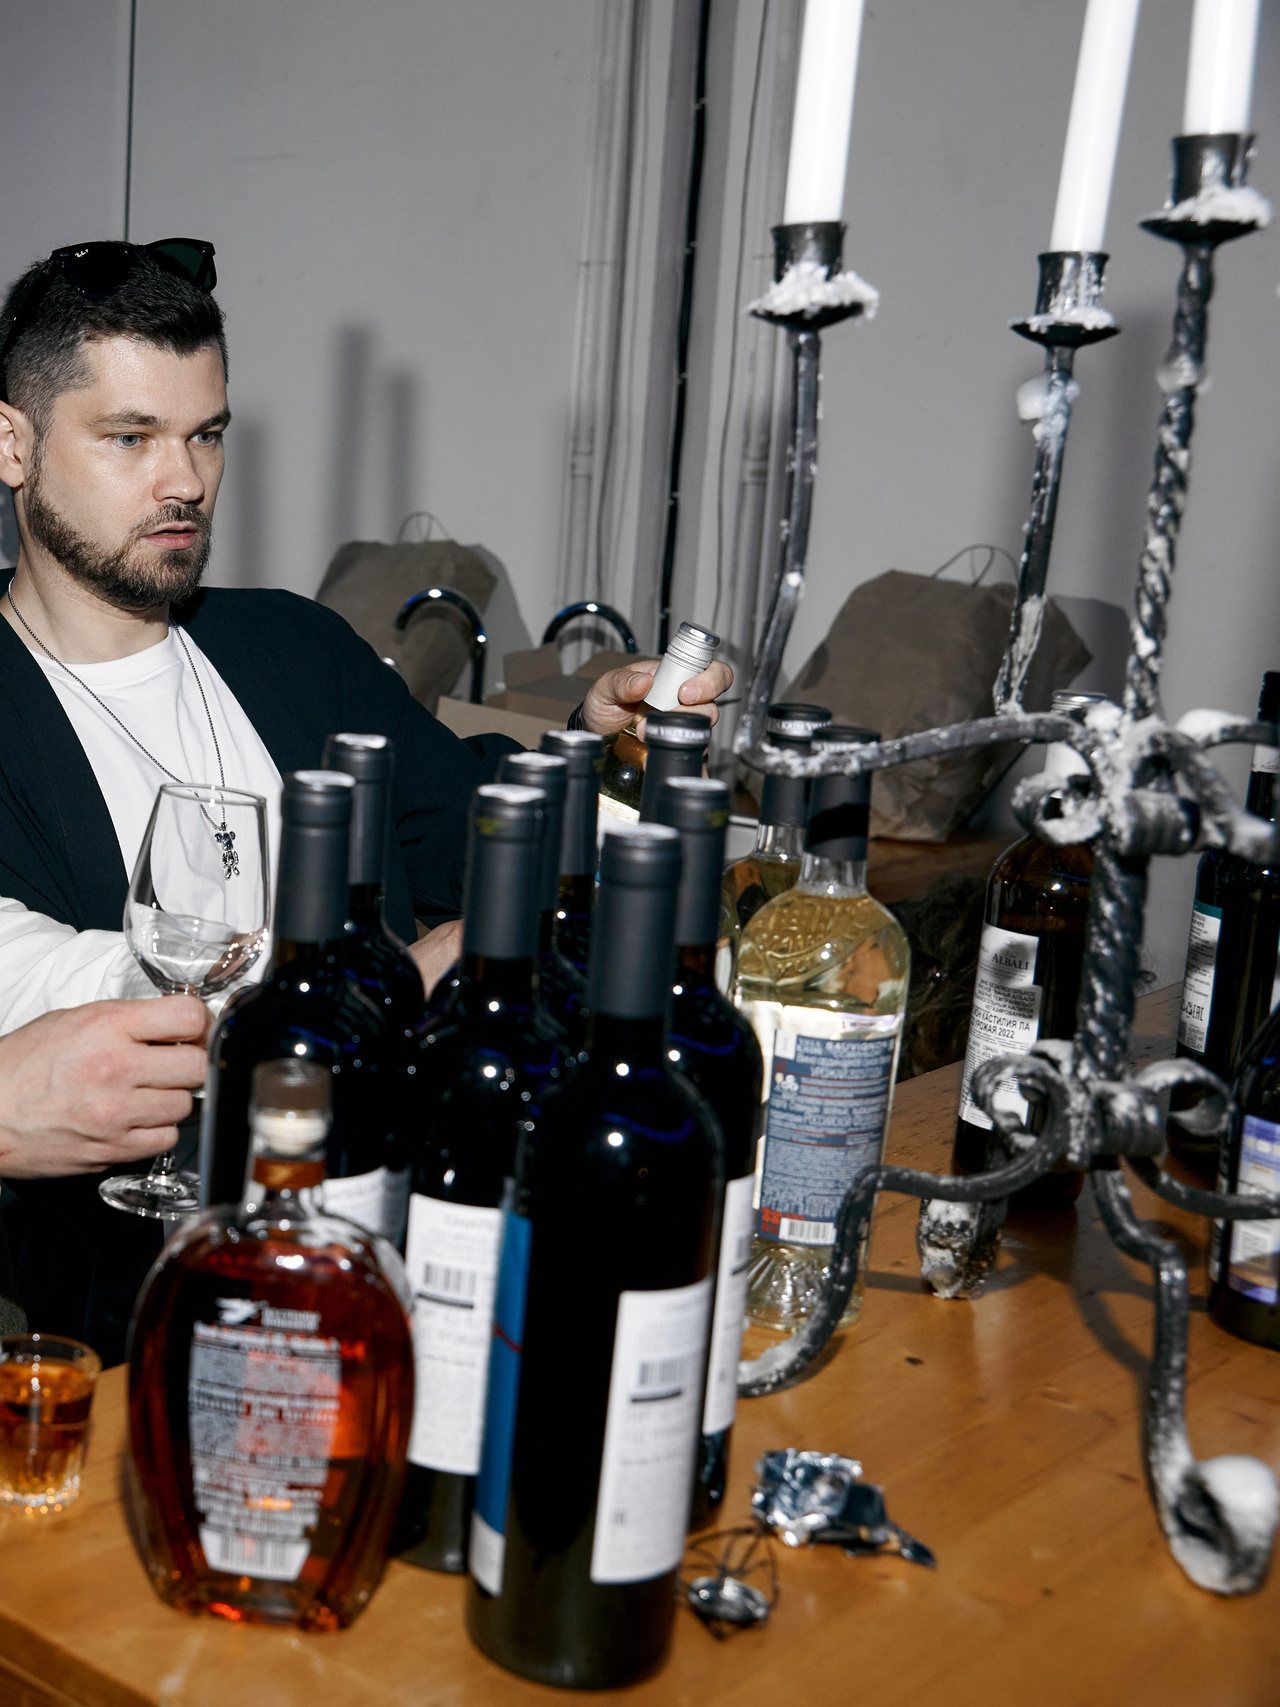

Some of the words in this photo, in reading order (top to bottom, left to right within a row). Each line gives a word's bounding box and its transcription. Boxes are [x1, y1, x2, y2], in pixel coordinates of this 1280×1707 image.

[992, 953, 1029, 970] ALBALI
[989, 981, 1036, 997] БЕЗАЛКОГОЛЬНОЕ
[974, 1019, 997, 1034] УРОЖАЯ
[998, 1027, 1015, 1039] 2022
[982, 1011, 1017, 1028] КАСТИЛИЯ
[1018, 1021, 1030, 1031] ЛА
